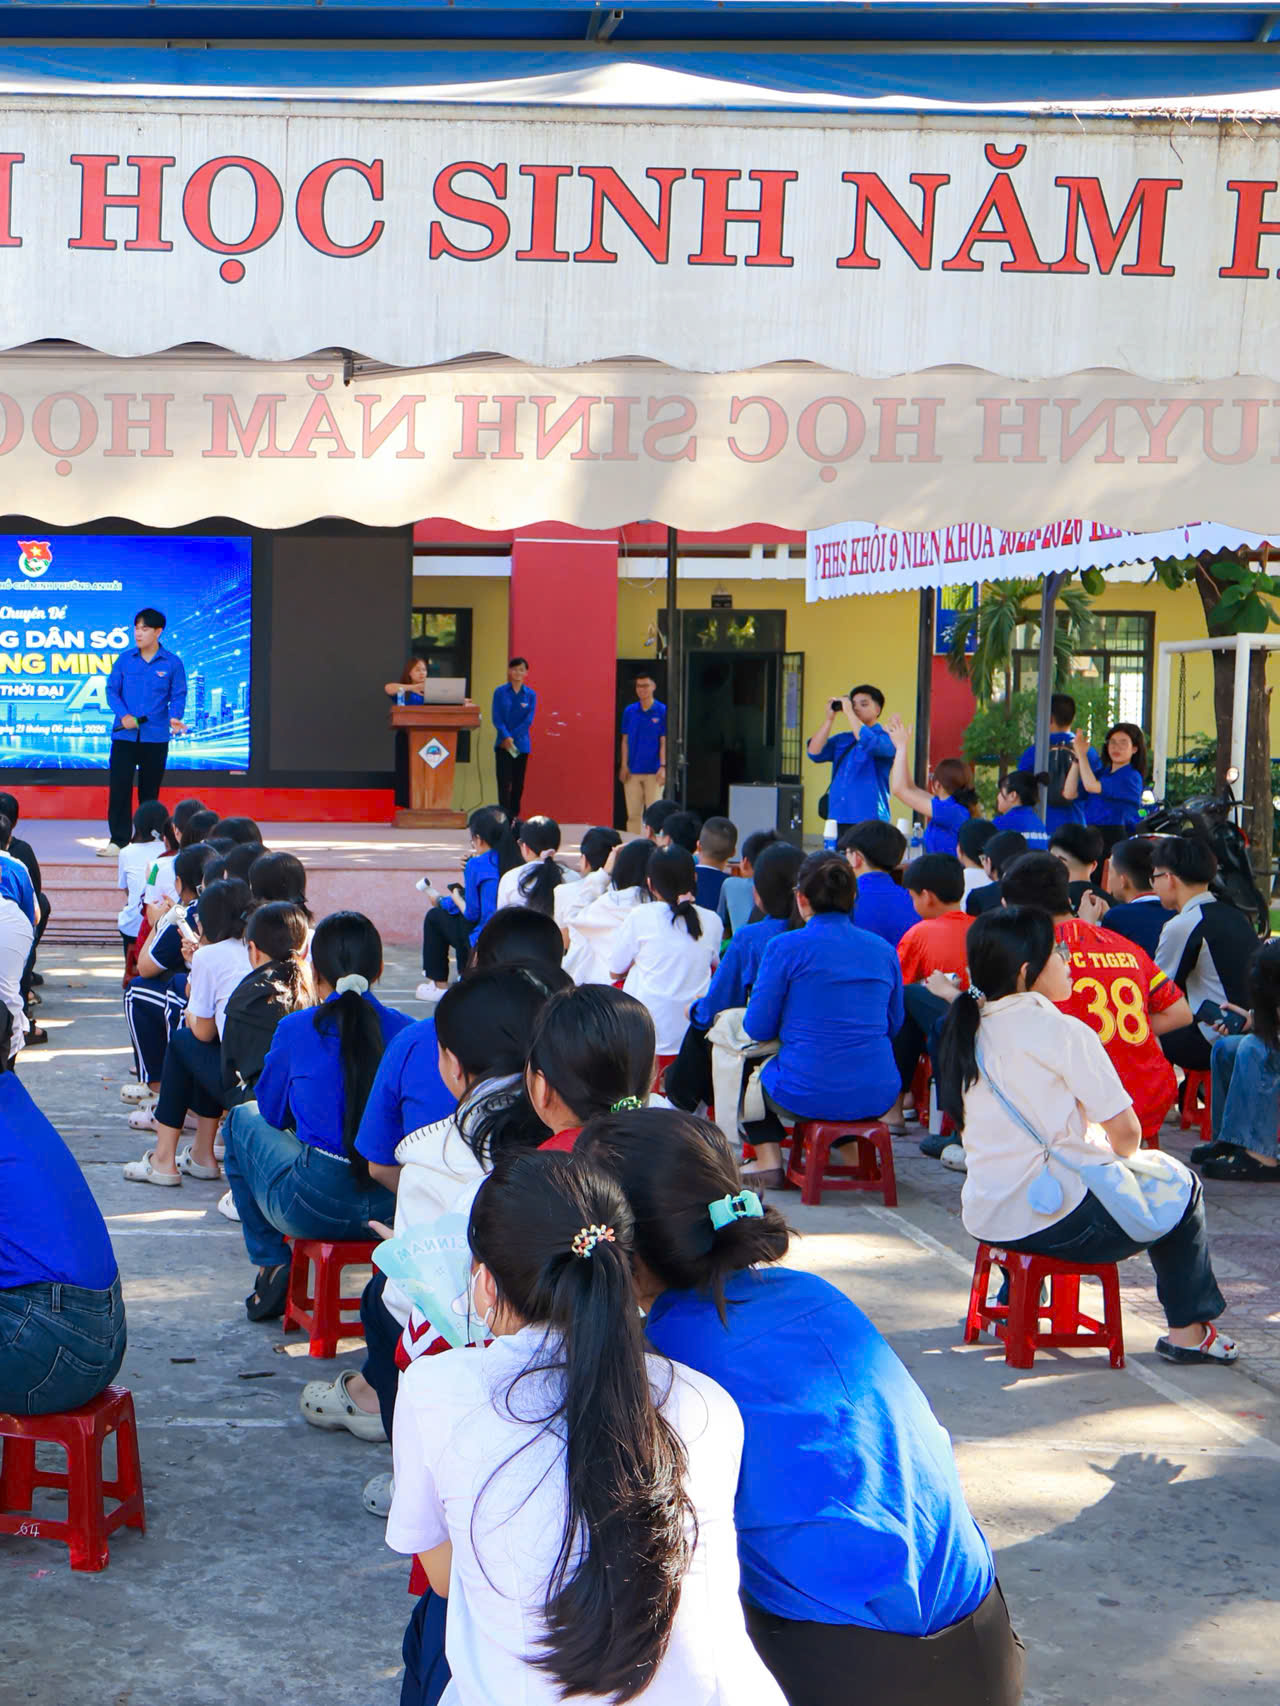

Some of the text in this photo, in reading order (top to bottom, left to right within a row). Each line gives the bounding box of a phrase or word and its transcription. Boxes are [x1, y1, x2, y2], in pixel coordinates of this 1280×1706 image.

[68, 154, 385, 284] HỌC
[428, 160, 799, 267] SINH
[836, 143, 1183, 276] NĂM
[814, 539, 847, 580] PHHS
[889, 533, 898, 571] 9
[25, 626, 85, 648] DÂN
[90, 627, 130, 648] SỐ
[51, 653, 119, 675] MIN
[1087, 952, 1140, 970] TIGER
[1072, 977, 1150, 1045] 38
